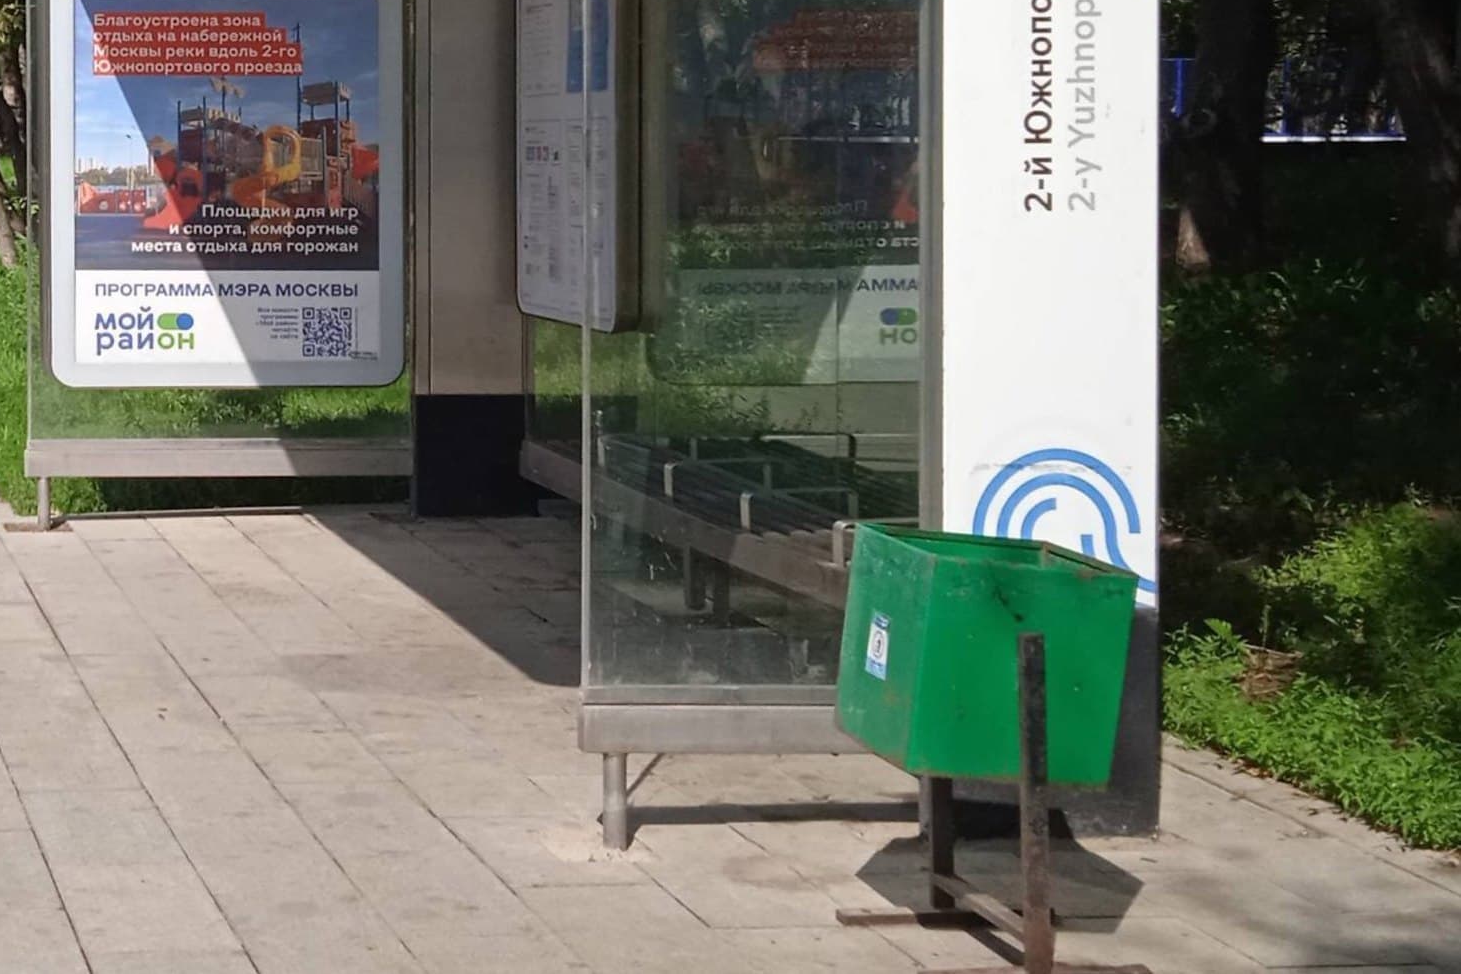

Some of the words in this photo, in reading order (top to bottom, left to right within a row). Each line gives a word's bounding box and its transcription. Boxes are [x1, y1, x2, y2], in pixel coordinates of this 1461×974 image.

[93, 13, 219, 30] Благоустроена
[222, 15, 260, 27] зона
[93, 31, 153, 43] отдыха
[157, 32, 176, 42] на
[180, 29, 282, 44] набережной
[93, 45, 161, 57] Москвы
[165, 47, 204, 60] реки
[209, 47, 257, 59] вдоль
[261, 45, 297, 57] 2-го
[93, 59, 230, 75] Южнопортового
[235, 62, 303, 75] проезда
[1023, 156, 1052, 213] 2-й
[1067, 156, 1102, 212] 2-y
[202, 204, 290, 220] Площадки
[294, 207, 325, 220] для
[330, 207, 358, 220] игр
[169, 224, 179, 234] и
[183, 224, 246, 237] спорта,
[250, 223, 358, 237] комфортные
[131, 242, 182, 253] места
[186, 242, 247, 254] отдыха
[251, 242, 282, 254] для
[287, 242, 358, 255] горожан
[95, 283, 214, 297] ПРОГРАММА
[218, 283, 271, 297] МЭРА
[276, 283, 359, 297] МОСКВЫ
[94, 306, 154, 330] мой
